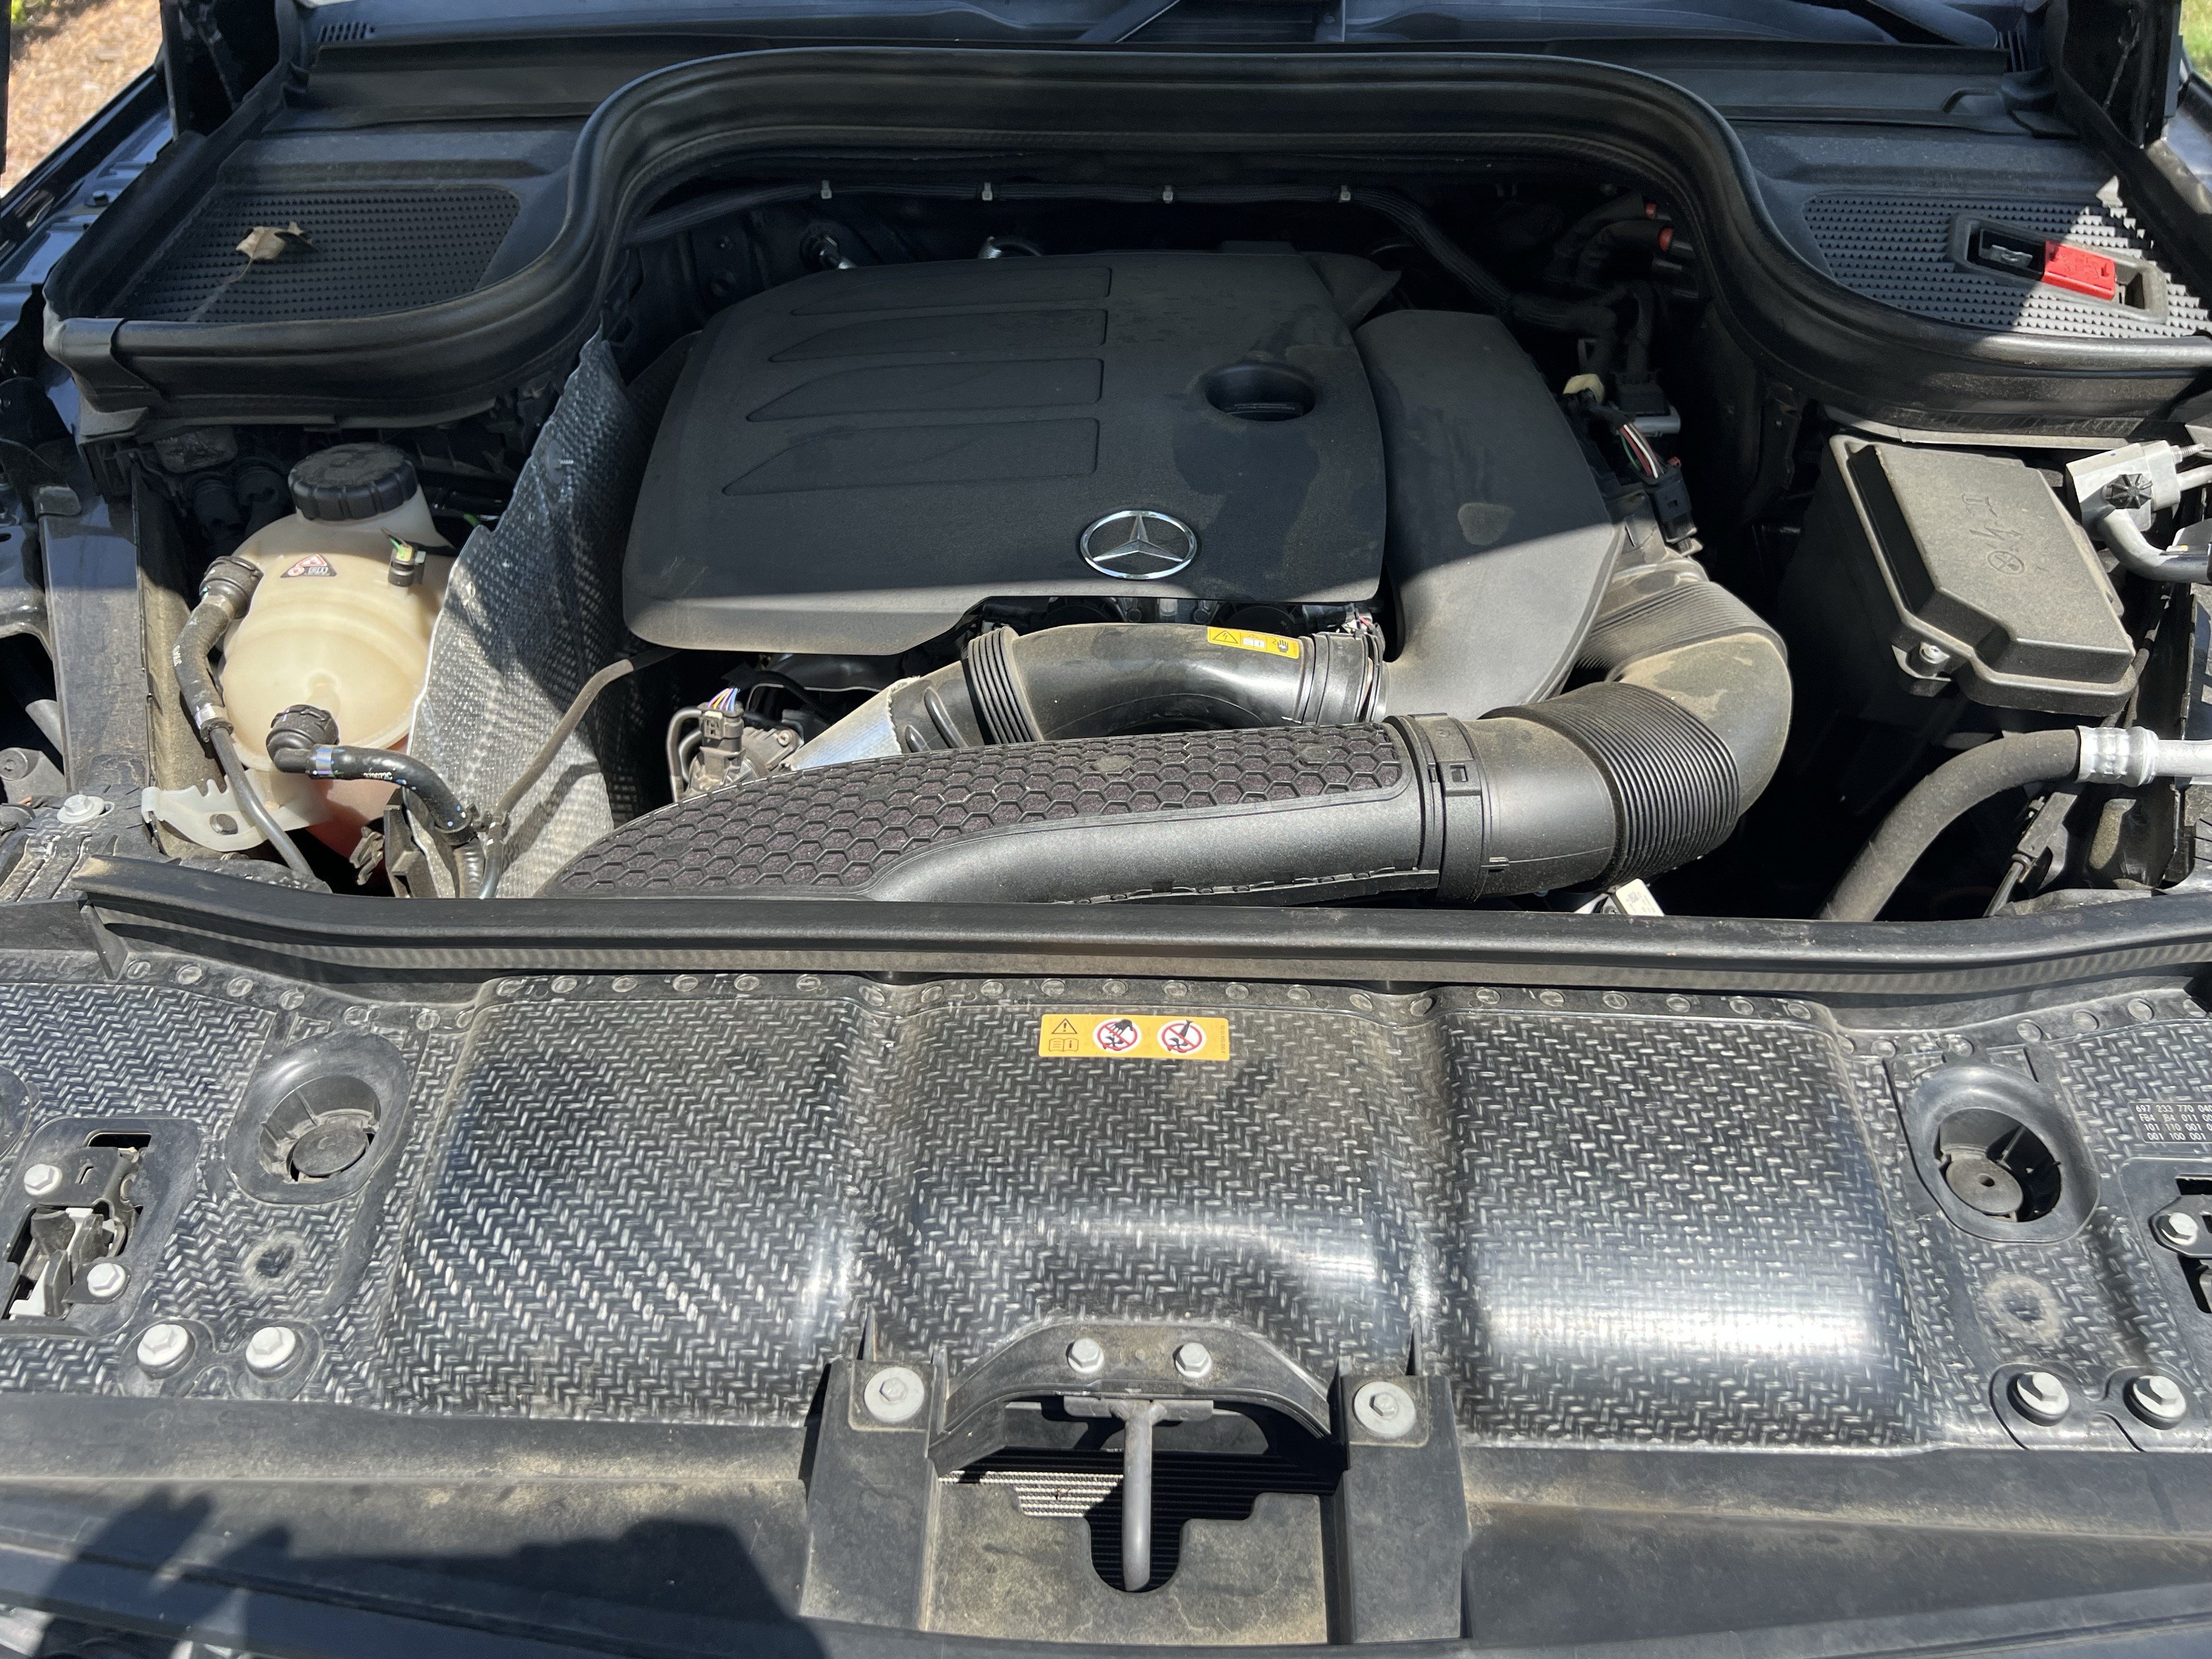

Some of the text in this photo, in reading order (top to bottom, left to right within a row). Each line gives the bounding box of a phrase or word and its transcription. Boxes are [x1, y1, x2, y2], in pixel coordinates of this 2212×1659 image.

[2147, 1132, 2207, 1141] 001 100 001
